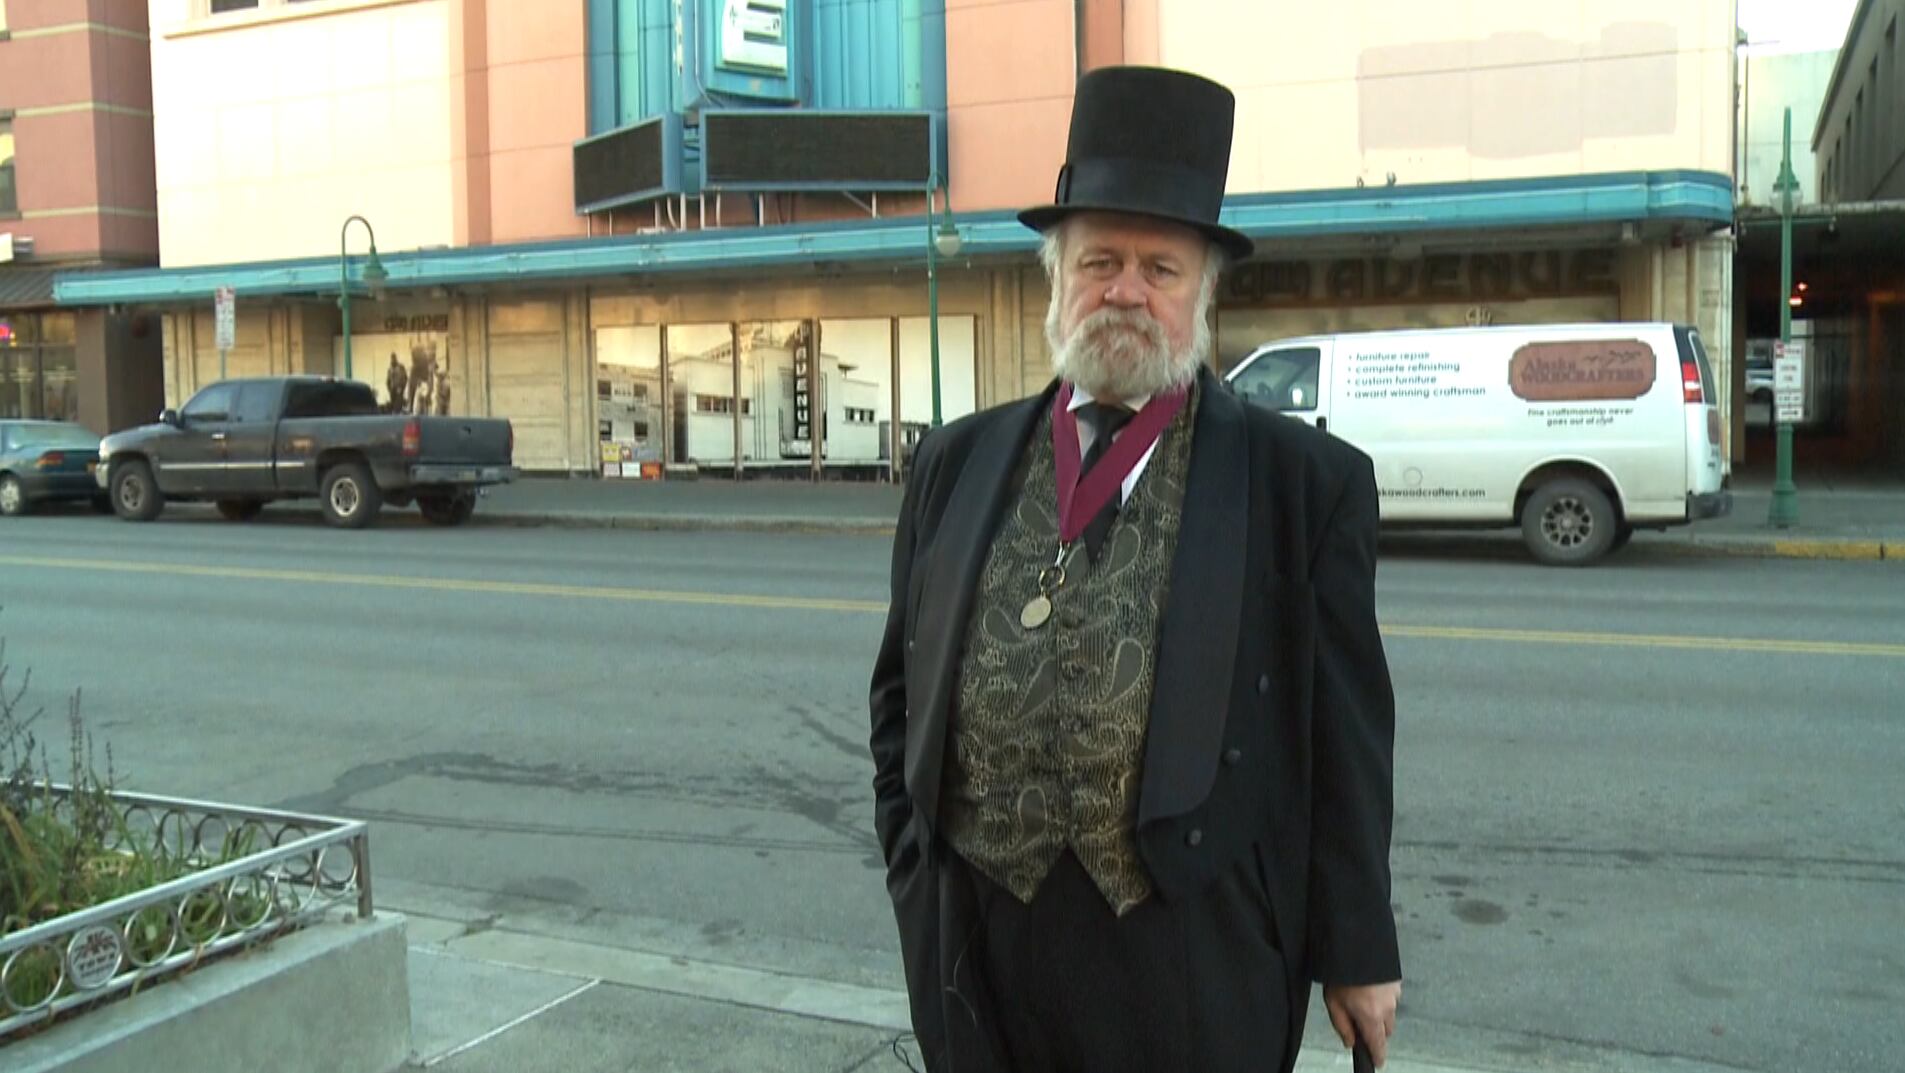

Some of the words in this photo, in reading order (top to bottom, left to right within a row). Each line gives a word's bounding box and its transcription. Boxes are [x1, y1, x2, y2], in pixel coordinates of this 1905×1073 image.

[1356, 352, 1397, 361] furniture
[1400, 351, 1430, 361] repair
[1355, 364, 1405, 375] complete
[1408, 362, 1460, 373] refinishing
[1355, 376, 1393, 386] custom
[1395, 375, 1437, 385] furniture
[1354, 389, 1387, 399] award
[1390, 387, 1430, 399] winning
[1433, 386, 1486, 397] craftsman
[1547, 407, 1607, 418] craftsmanship
[1609, 408, 1633, 416] never
[1570, 417, 1584, 426] out
[1586, 416, 1595, 425] of
